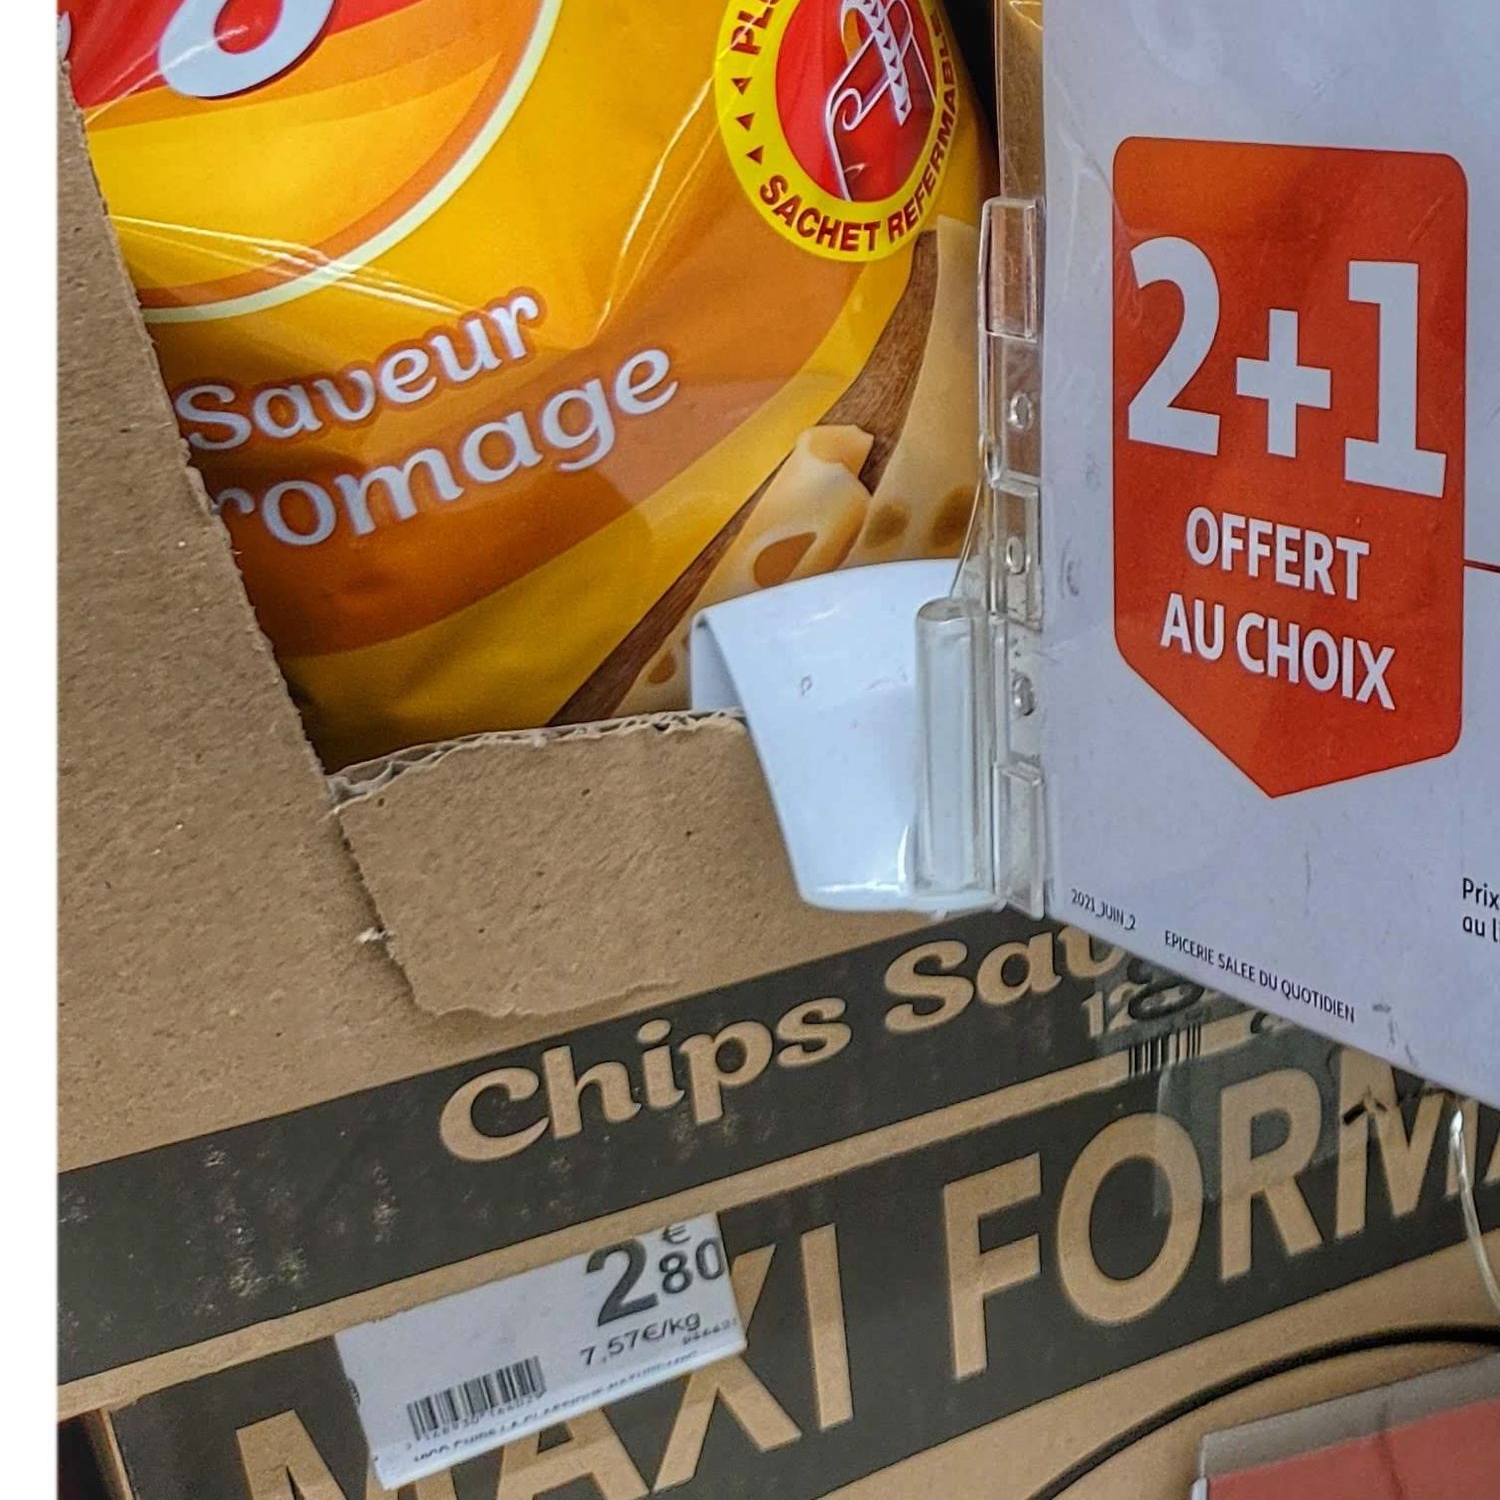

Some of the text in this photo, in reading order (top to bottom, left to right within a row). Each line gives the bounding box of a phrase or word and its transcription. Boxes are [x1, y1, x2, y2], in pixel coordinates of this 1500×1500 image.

[759, 174, 881, 253] SACHET
[174, 295, 540, 452] Saveur
[1127, 235, 1448, 499] 2+1
[1185, 506, 1371, 601] OFFERT
[1160, 592, 1396, 711] AU CHOIX
[1462, 877, 1500, 911] Prix
[1462, 915, 1486, 937] au
[1164, 930, 1215, 965] EPICERIE
[1217, 953, 1256, 983] SALEE
[1258, 969, 1280, 992] DU
[1280, 979, 1356, 1024] QUOTIDIEN
[438, 1018, 853, 1162] Chips
[586, 1237, 661, 1328] 2
[658, 1237, 724, 1297] 80
